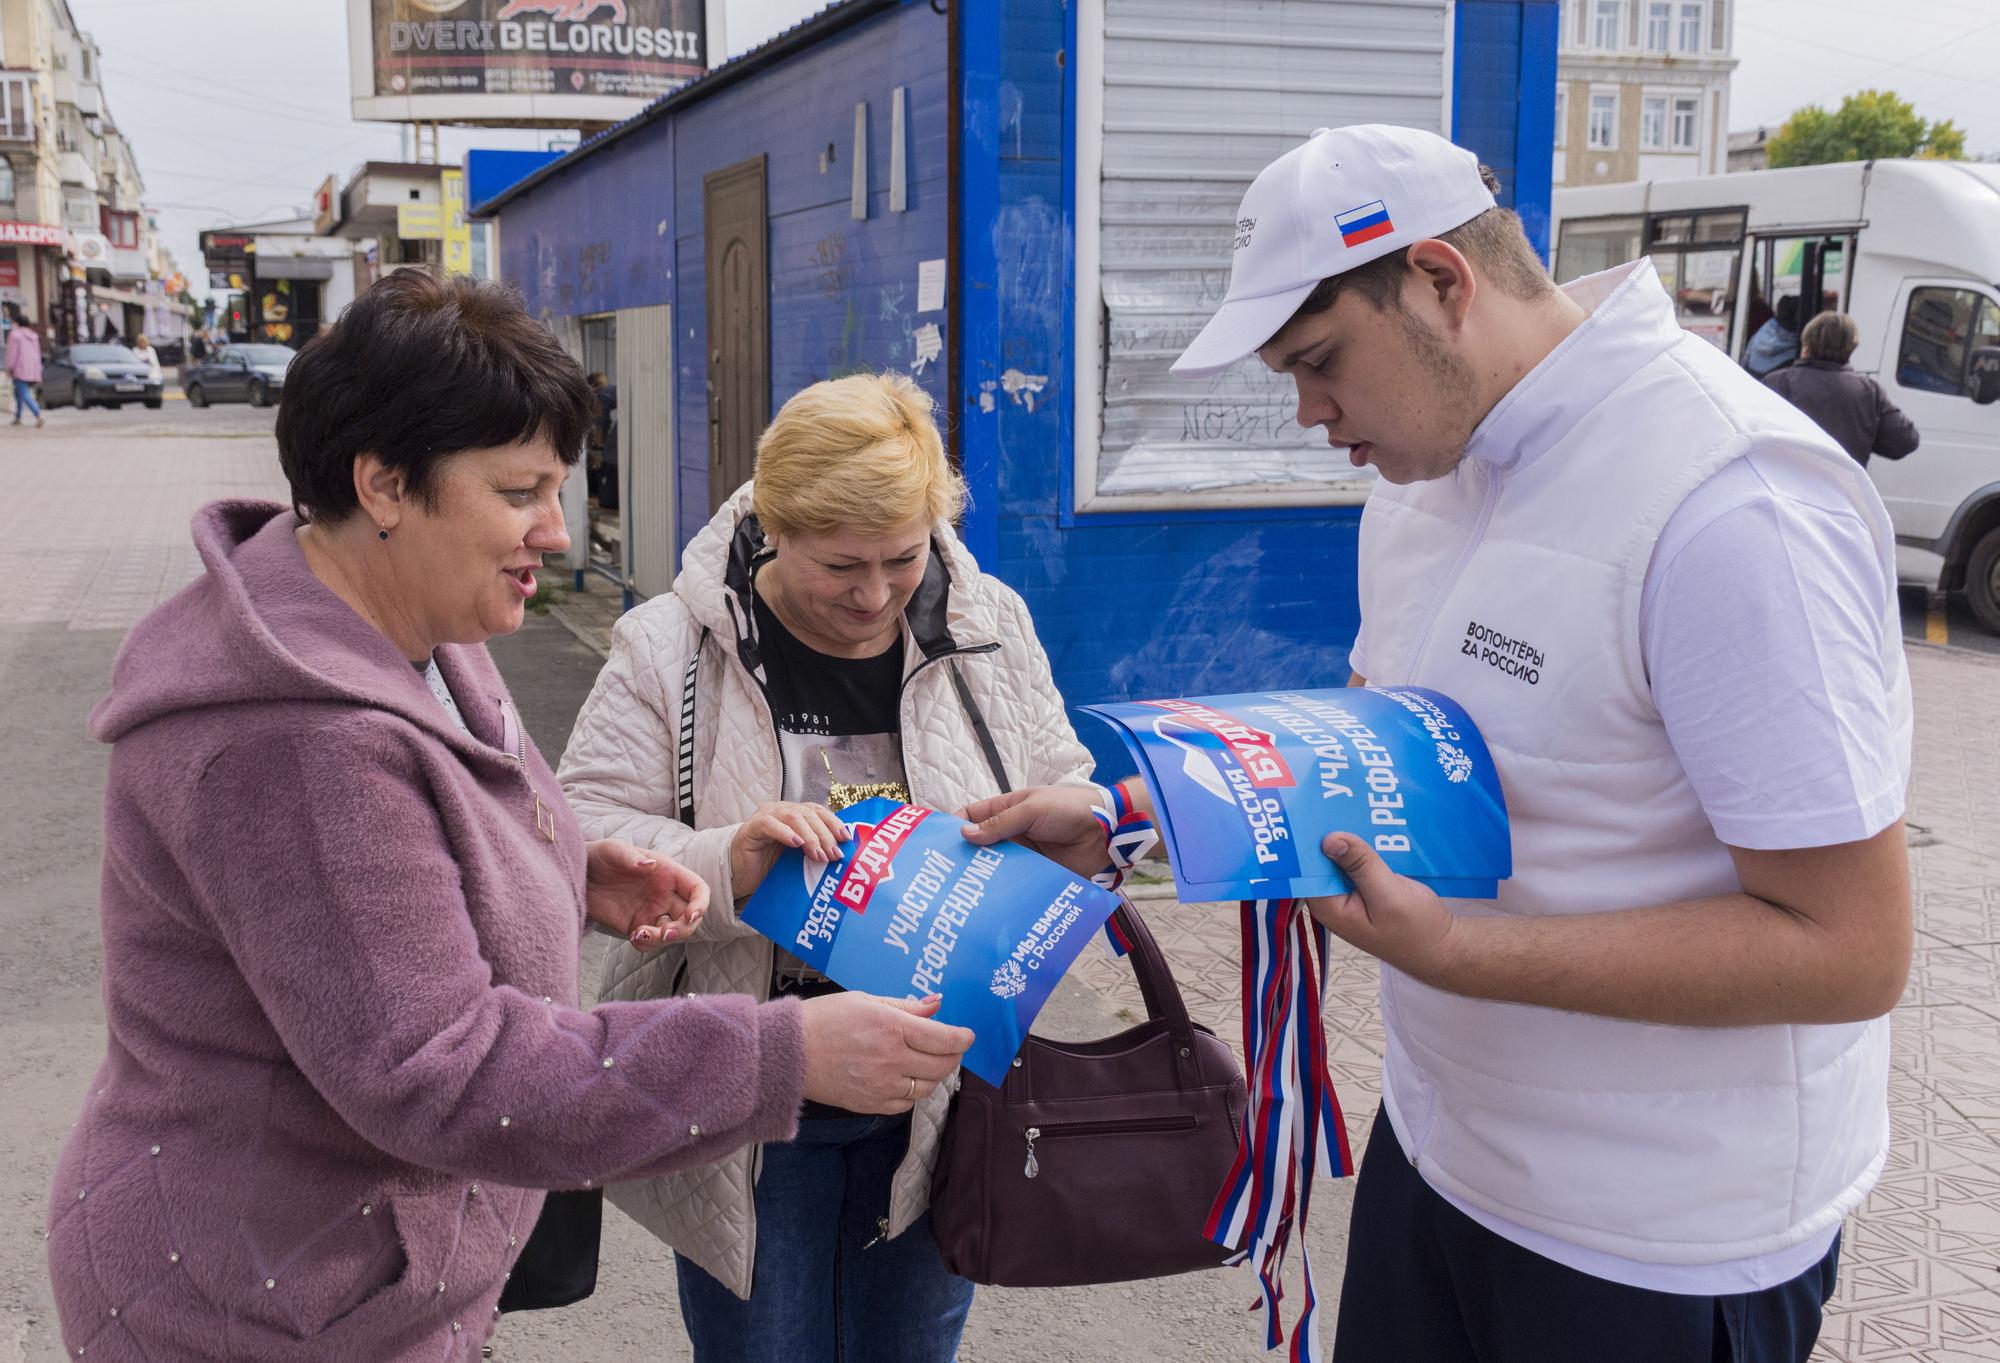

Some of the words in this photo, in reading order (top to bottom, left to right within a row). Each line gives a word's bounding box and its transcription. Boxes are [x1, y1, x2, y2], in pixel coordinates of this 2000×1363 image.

[389, 21, 495, 51] DVERI
[500, 22, 699, 60] BELORUSSII
[1466, 620, 1545, 668] ВОЛОНТЁРЫ
[1481, 647, 1540, 685] РОССИЮ
[789, 712, 830, 726] 1981
[1416, 713, 1446, 740] МЫ
[1245, 705, 1354, 799] УЧАСТВУЙ
[1224, 768, 1279, 864] РОССИЯ
[1262, 798, 1289, 841] ЭТО
[840, 805, 926, 904] БУДУЩЕЕ
[1374, 834, 1411, 852] В
[795, 874, 840, 950] РОССИЯ
[818, 906, 841, 943] ЭТО
[883, 847, 957, 955] УЧАСТВУЙ
[910, 845, 1006, 996] РЕФЕРЕНДУМЕ!
[1011, 931, 1041, 963] МЫ
[1031, 881, 1085, 937] ВМЕСТЕ
